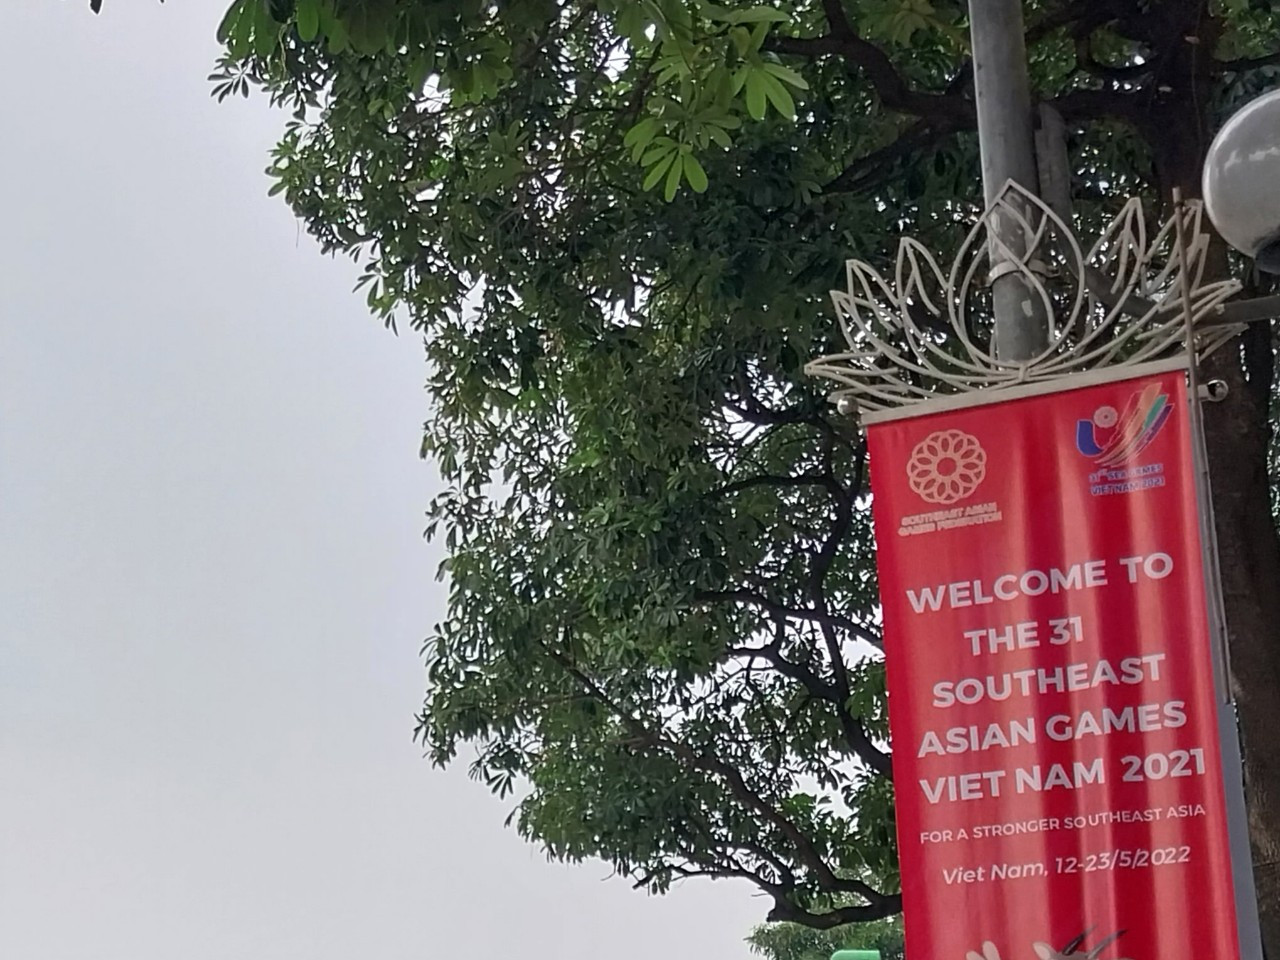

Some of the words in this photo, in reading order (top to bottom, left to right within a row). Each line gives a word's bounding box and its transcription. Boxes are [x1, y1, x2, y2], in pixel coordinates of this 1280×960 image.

[906, 560, 1108, 614] WELCOME
[1120, 552, 1174, 585] TO
[964, 621, 1040, 656] THE
[1049, 615, 1084, 646] 31
[933, 653, 1166, 708] SOUTHEAST
[918, 717, 1036, 758] ASIAN
[1046, 700, 1187, 743] GAMES
[919, 770, 1006, 804] VIET
[1015, 758, 1106, 794] NAM
[1120, 748, 1206, 783] 2021
[920, 828, 953, 844] FOR
[957, 827, 969, 841] A
[973, 817, 1060, 840] STRONGER
[1064, 808, 1162, 830] SOUTHEAST
[1166, 803, 1206, 819] ASIA
[943, 865, 984, 886] Viet
[991, 859, 1049, 881] Nam,
[1056, 845, 1191, 874] 12-23/5/2022
